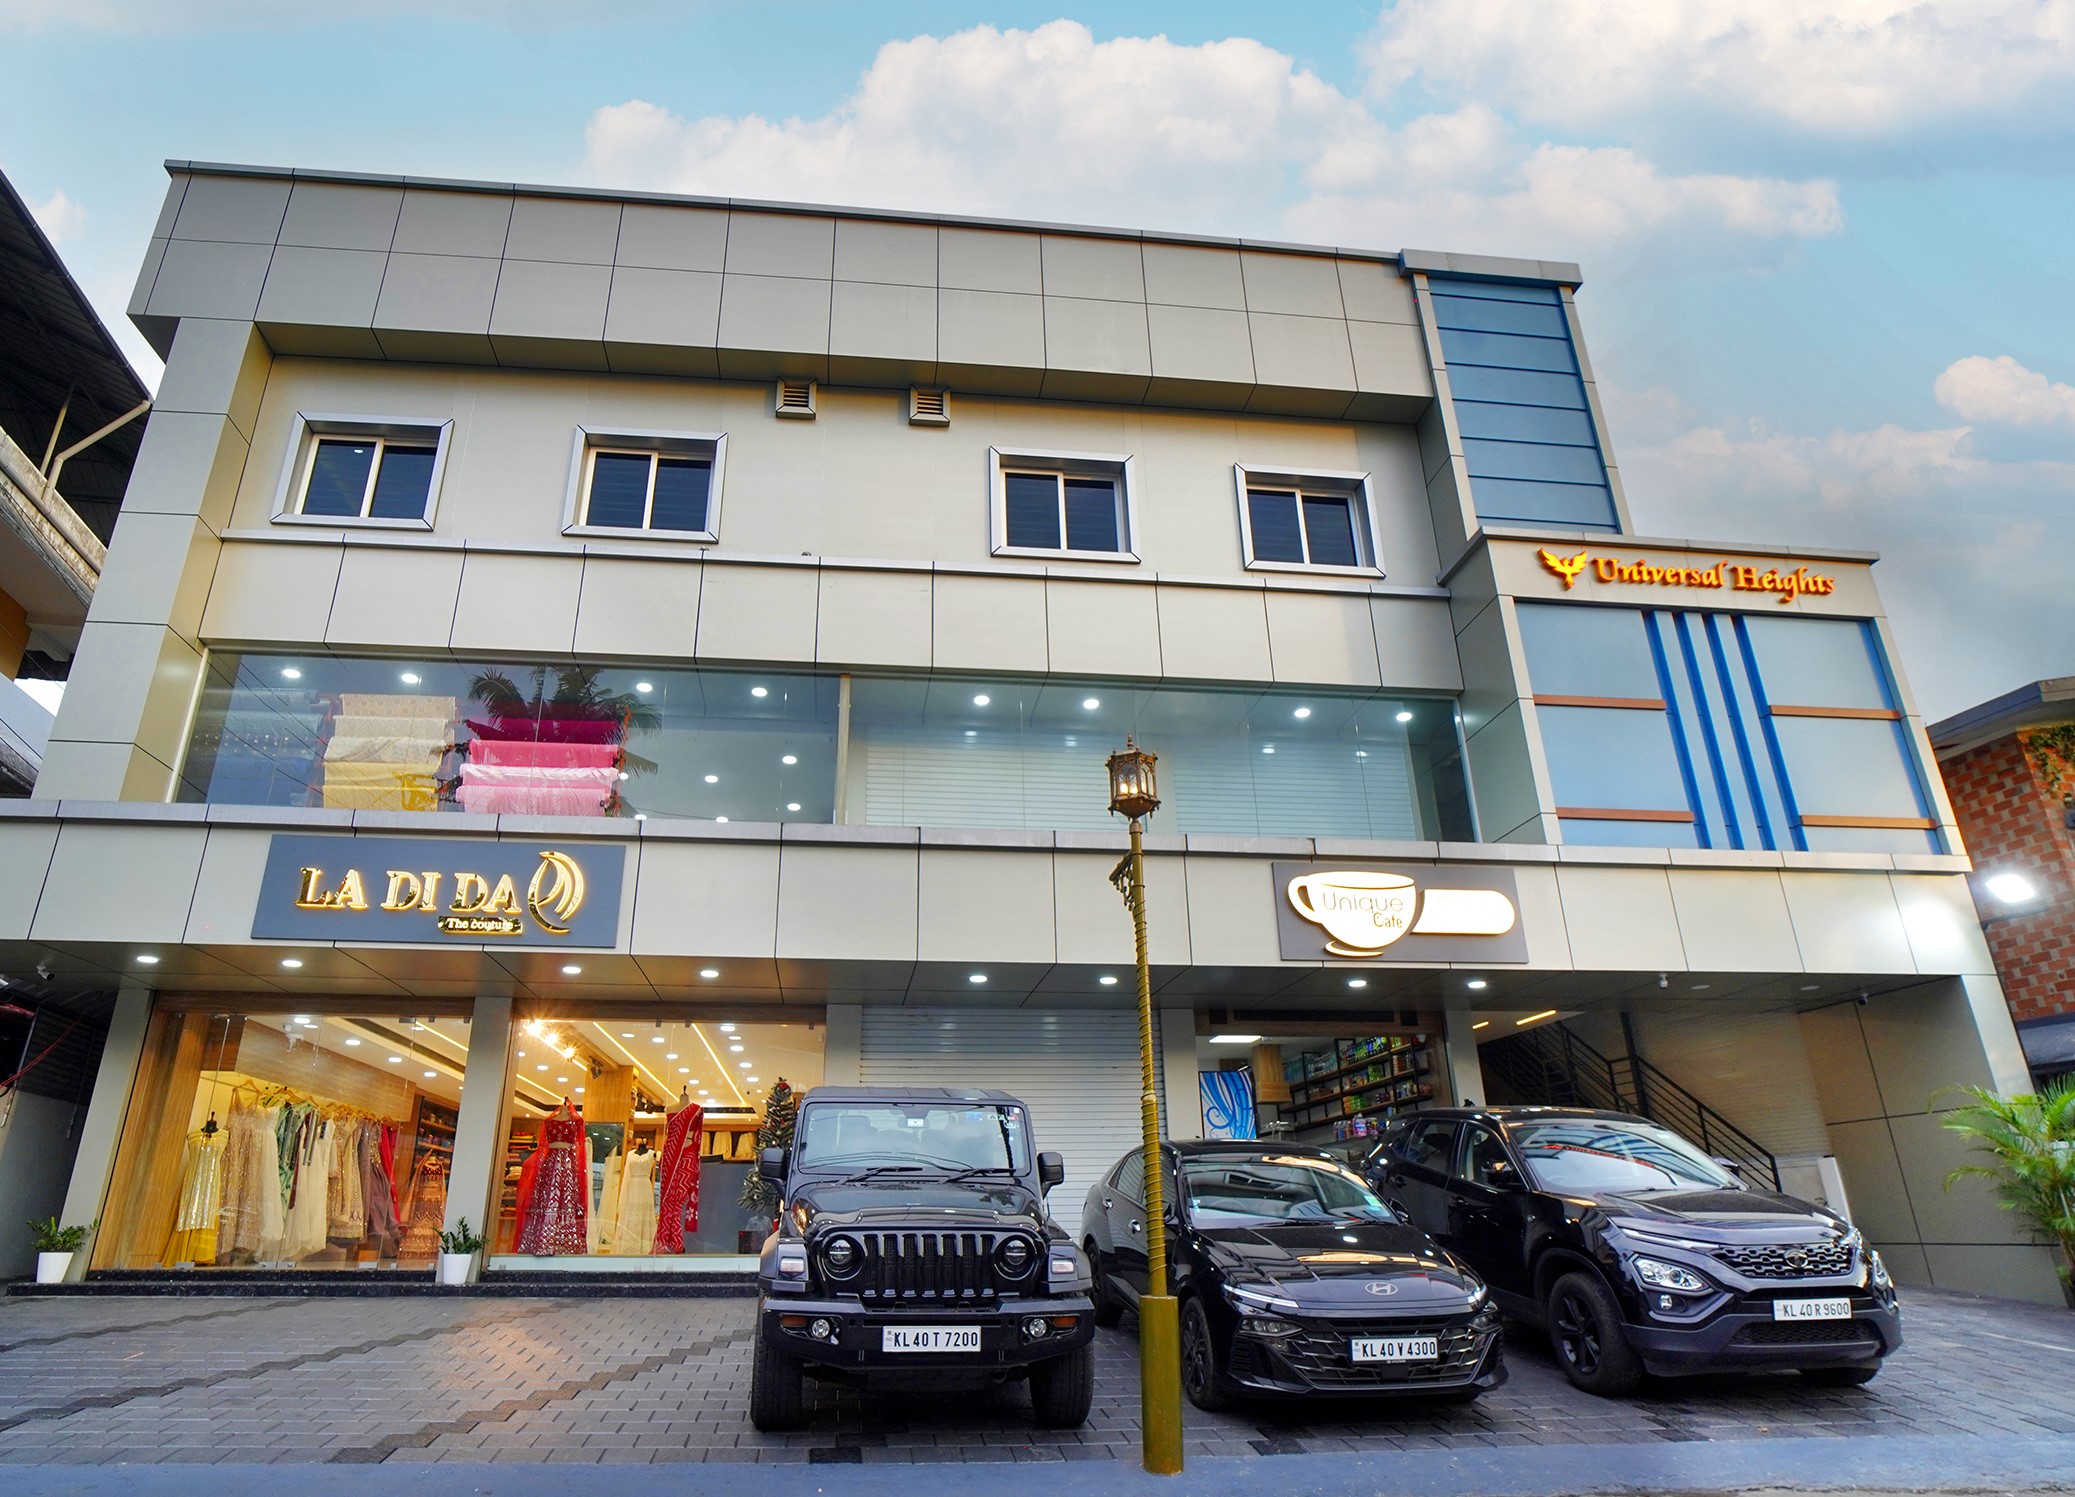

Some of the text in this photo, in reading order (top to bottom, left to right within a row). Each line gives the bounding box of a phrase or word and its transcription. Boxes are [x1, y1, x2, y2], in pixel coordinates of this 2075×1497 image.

[1591, 557, 1835, 604] Universal Heights
[294, 867, 522, 914] LA DI DA
[1321, 891, 1404, 913] Unique
[446, 917, 514, 931] The couture
[1782, 1302, 1850, 1317] KL 40 R 9600
[893, 1331, 978, 1347] KL 40 T 7200
[1361, 1341, 1436, 1358] KL 40 V 4300
